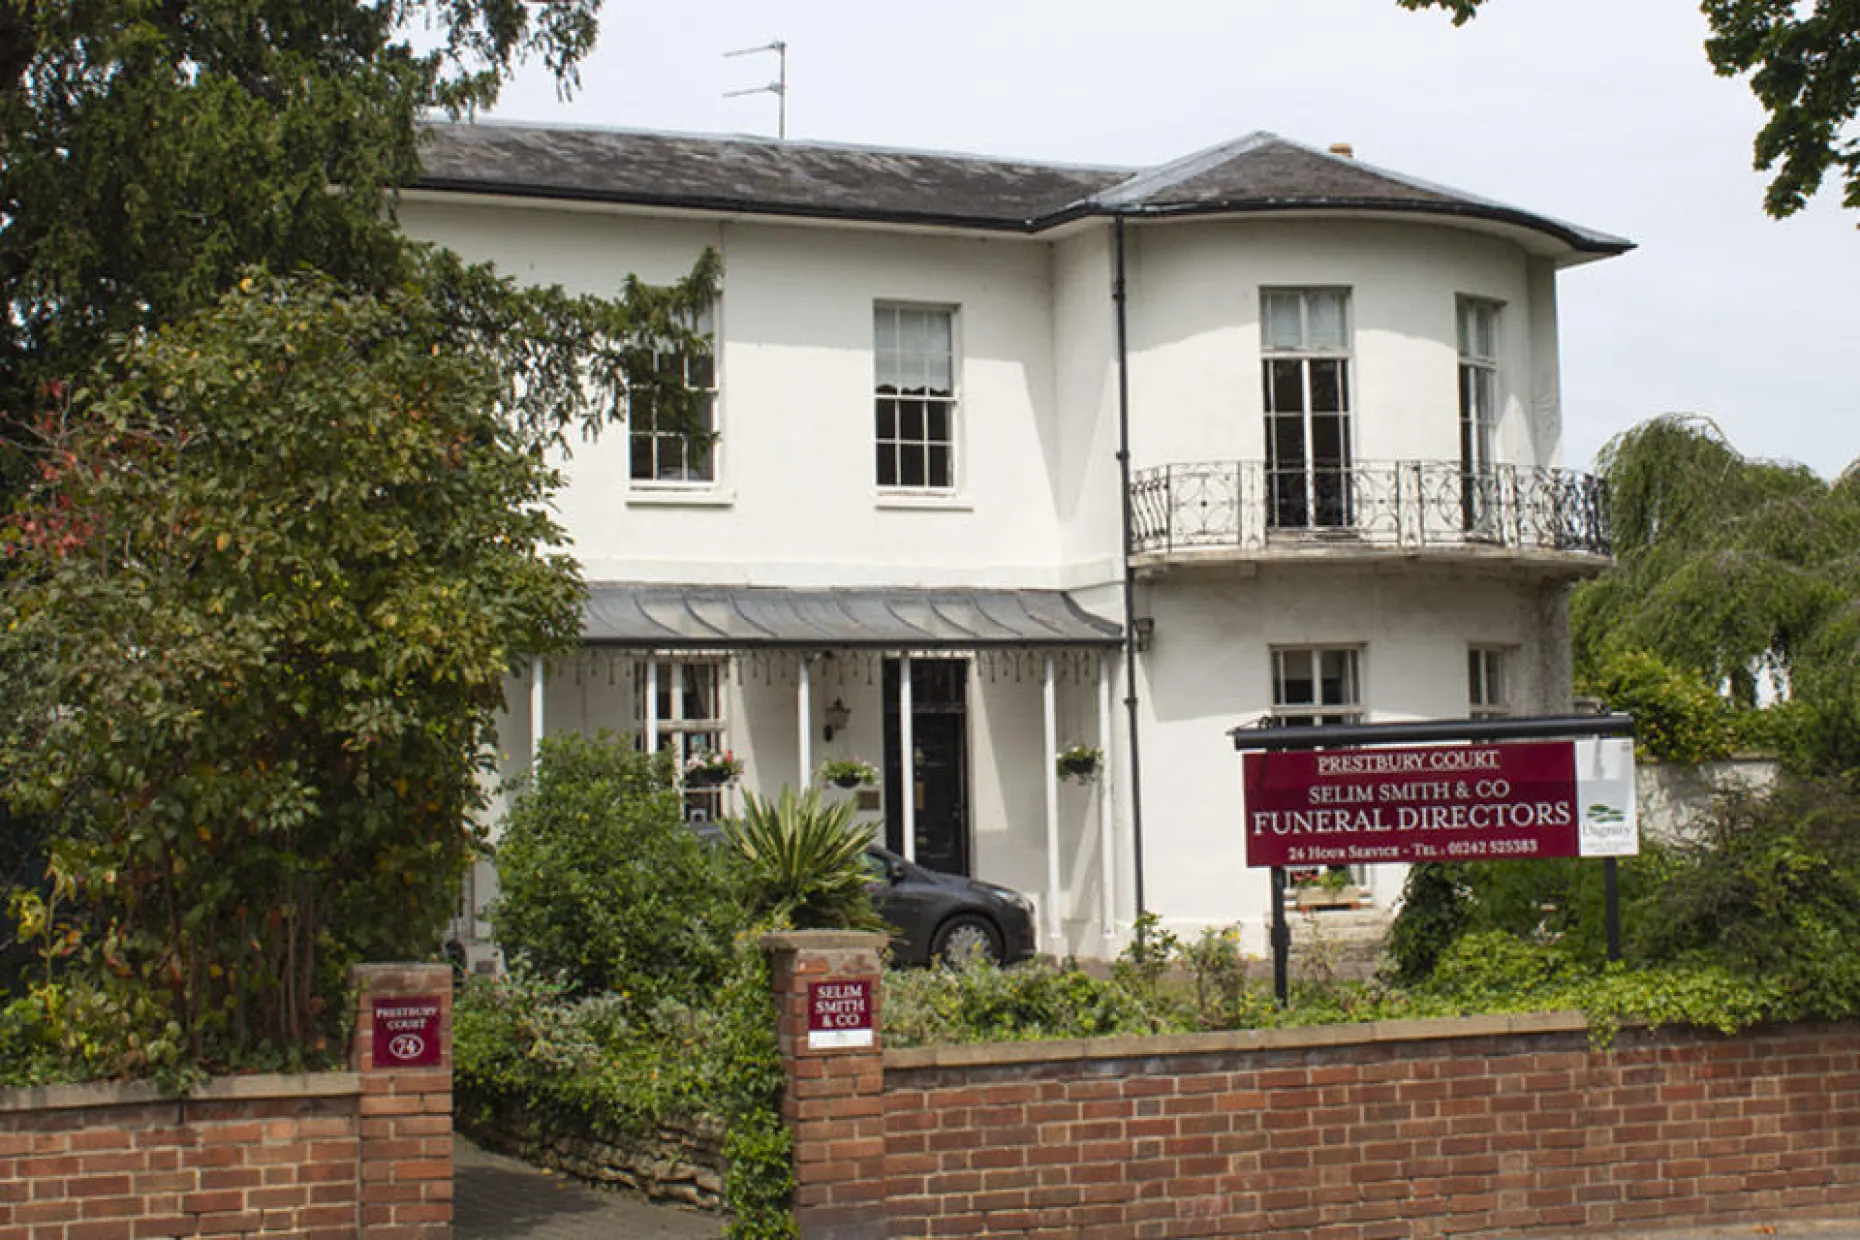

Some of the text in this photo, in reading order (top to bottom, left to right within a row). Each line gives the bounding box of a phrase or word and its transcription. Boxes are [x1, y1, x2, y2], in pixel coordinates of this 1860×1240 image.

[1317, 750, 1500, 774] PRESTBURY COURT
[1309, 779, 1510, 805] SELIM SMITH & CO
[1253, 802, 1571, 835] FUNERAL DIRECTORS
[817, 985, 863, 998] SELIM
[816, 999, 865, 1013] SMITH
[822, 1013, 860, 1027] & CO
